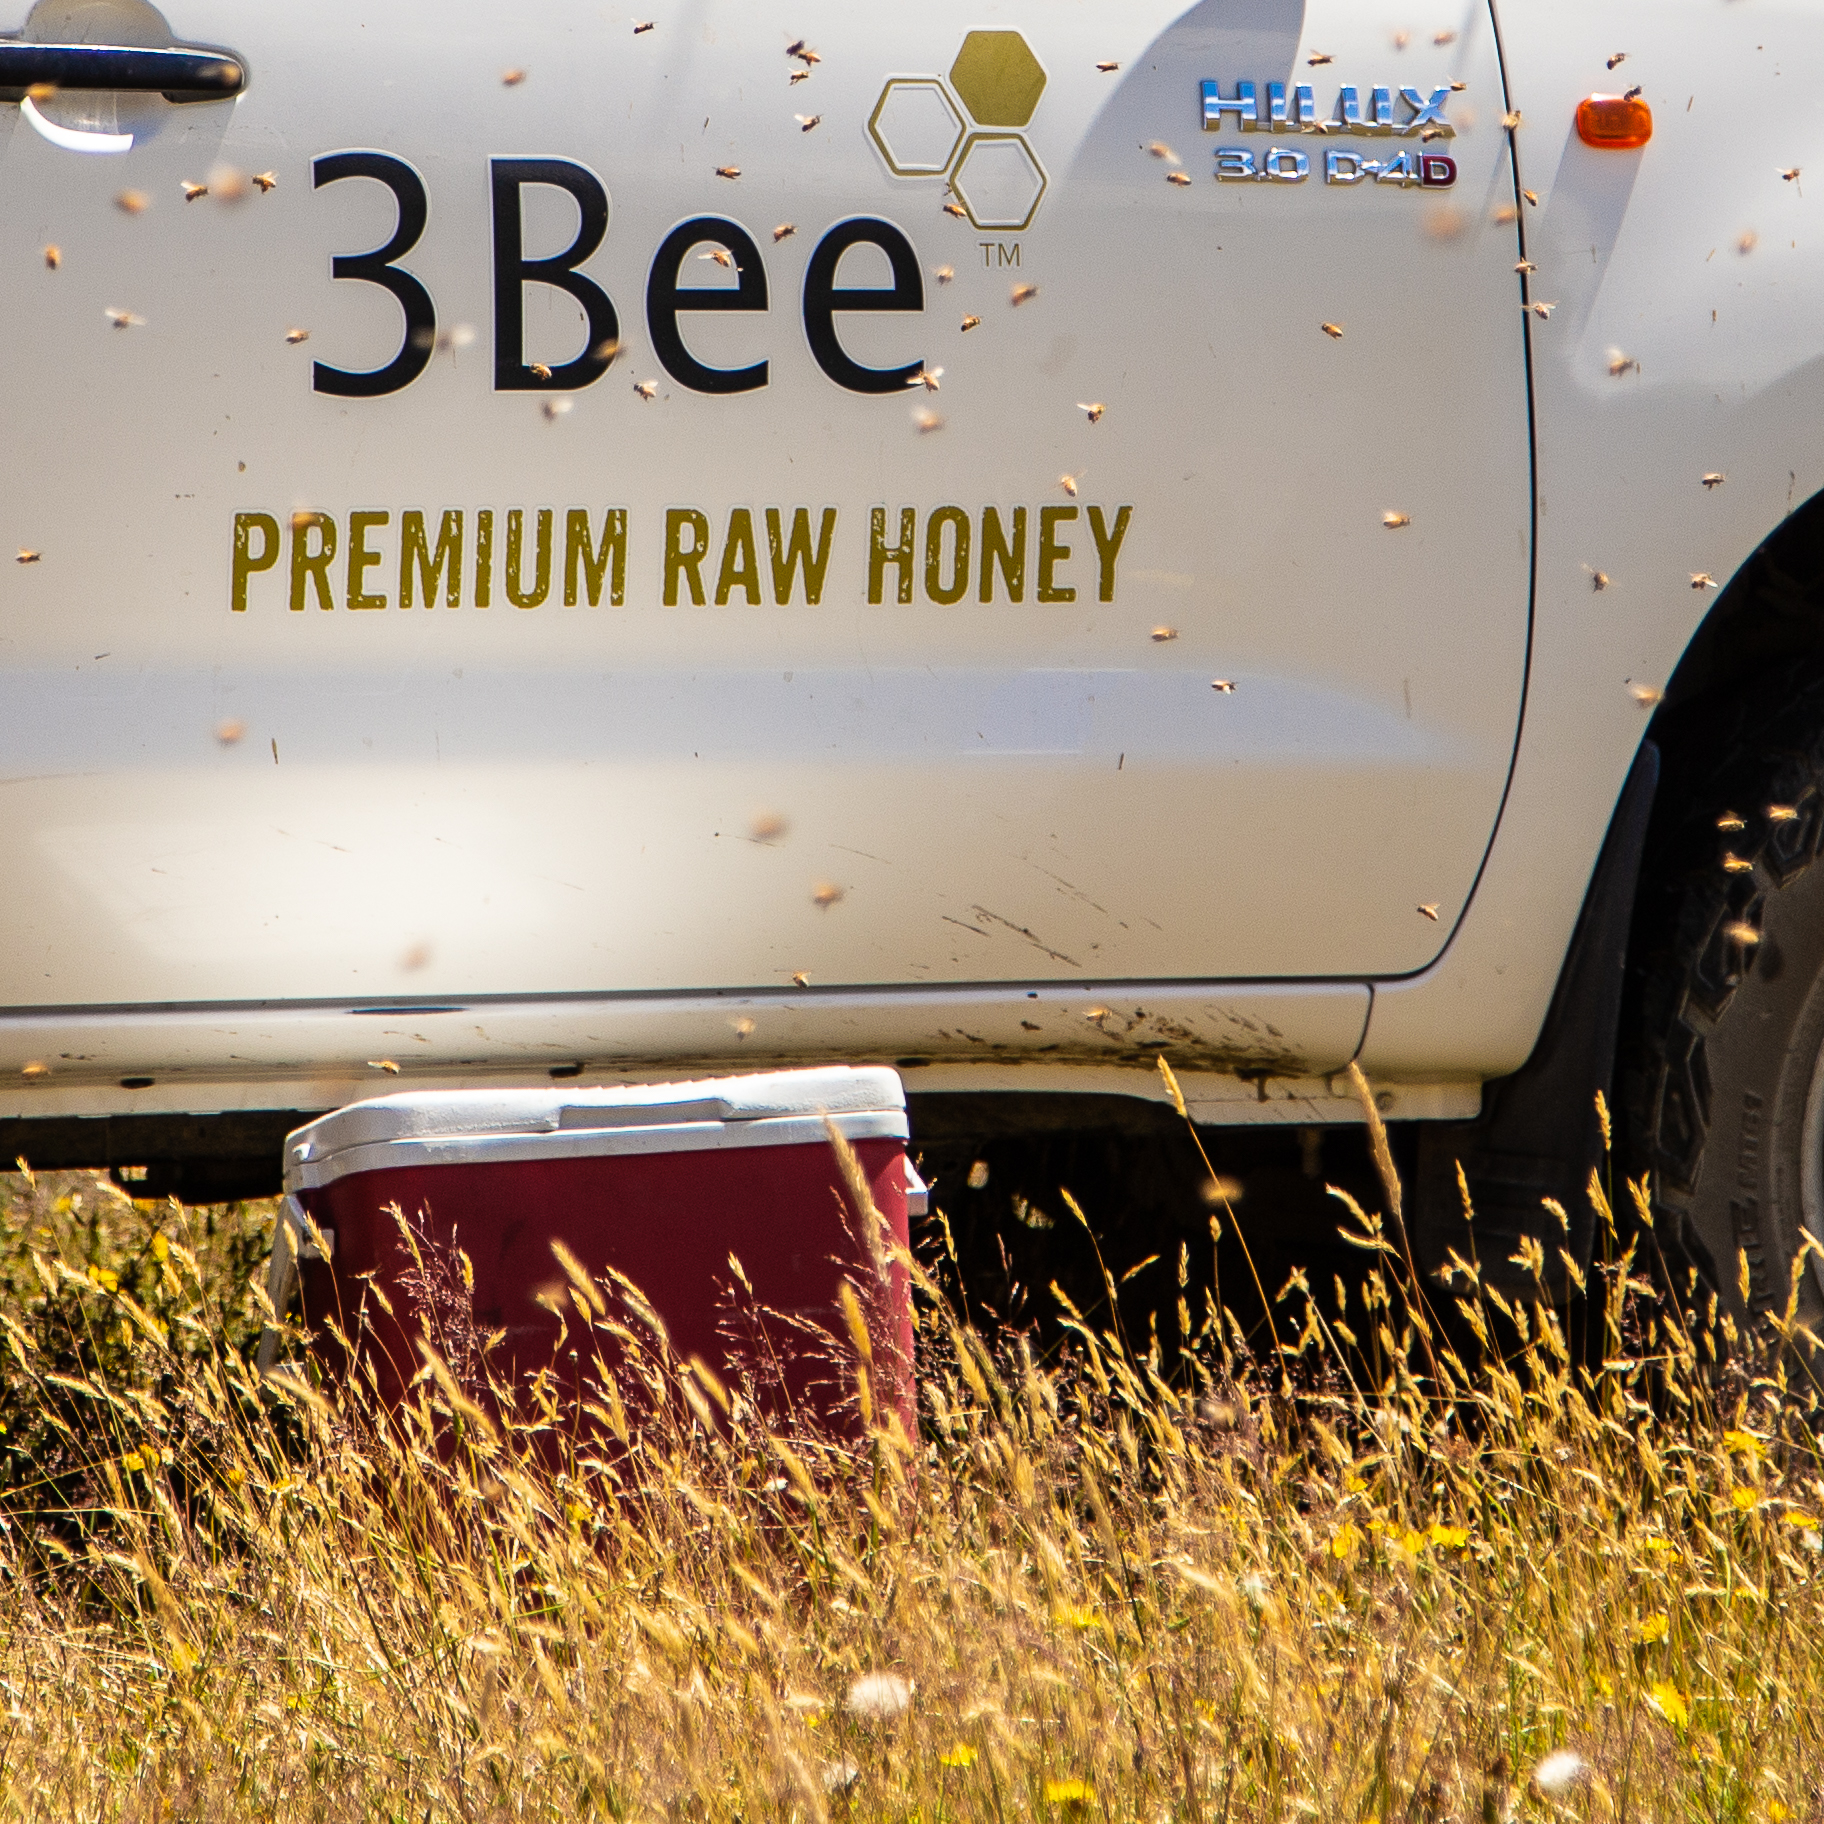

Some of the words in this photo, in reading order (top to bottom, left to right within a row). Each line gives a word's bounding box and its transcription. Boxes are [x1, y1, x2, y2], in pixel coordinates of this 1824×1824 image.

[1201, 80, 1457, 137] HILUX
[1215, 148, 1310, 183] 3.0
[1326, 149, 1458, 189] D-4D
[979, 242, 1020, 267] TM
[231, 509, 628, 611] PREMIUM
[662, 507, 837, 606] RAW
[868, 505, 1133, 604] HONEY
